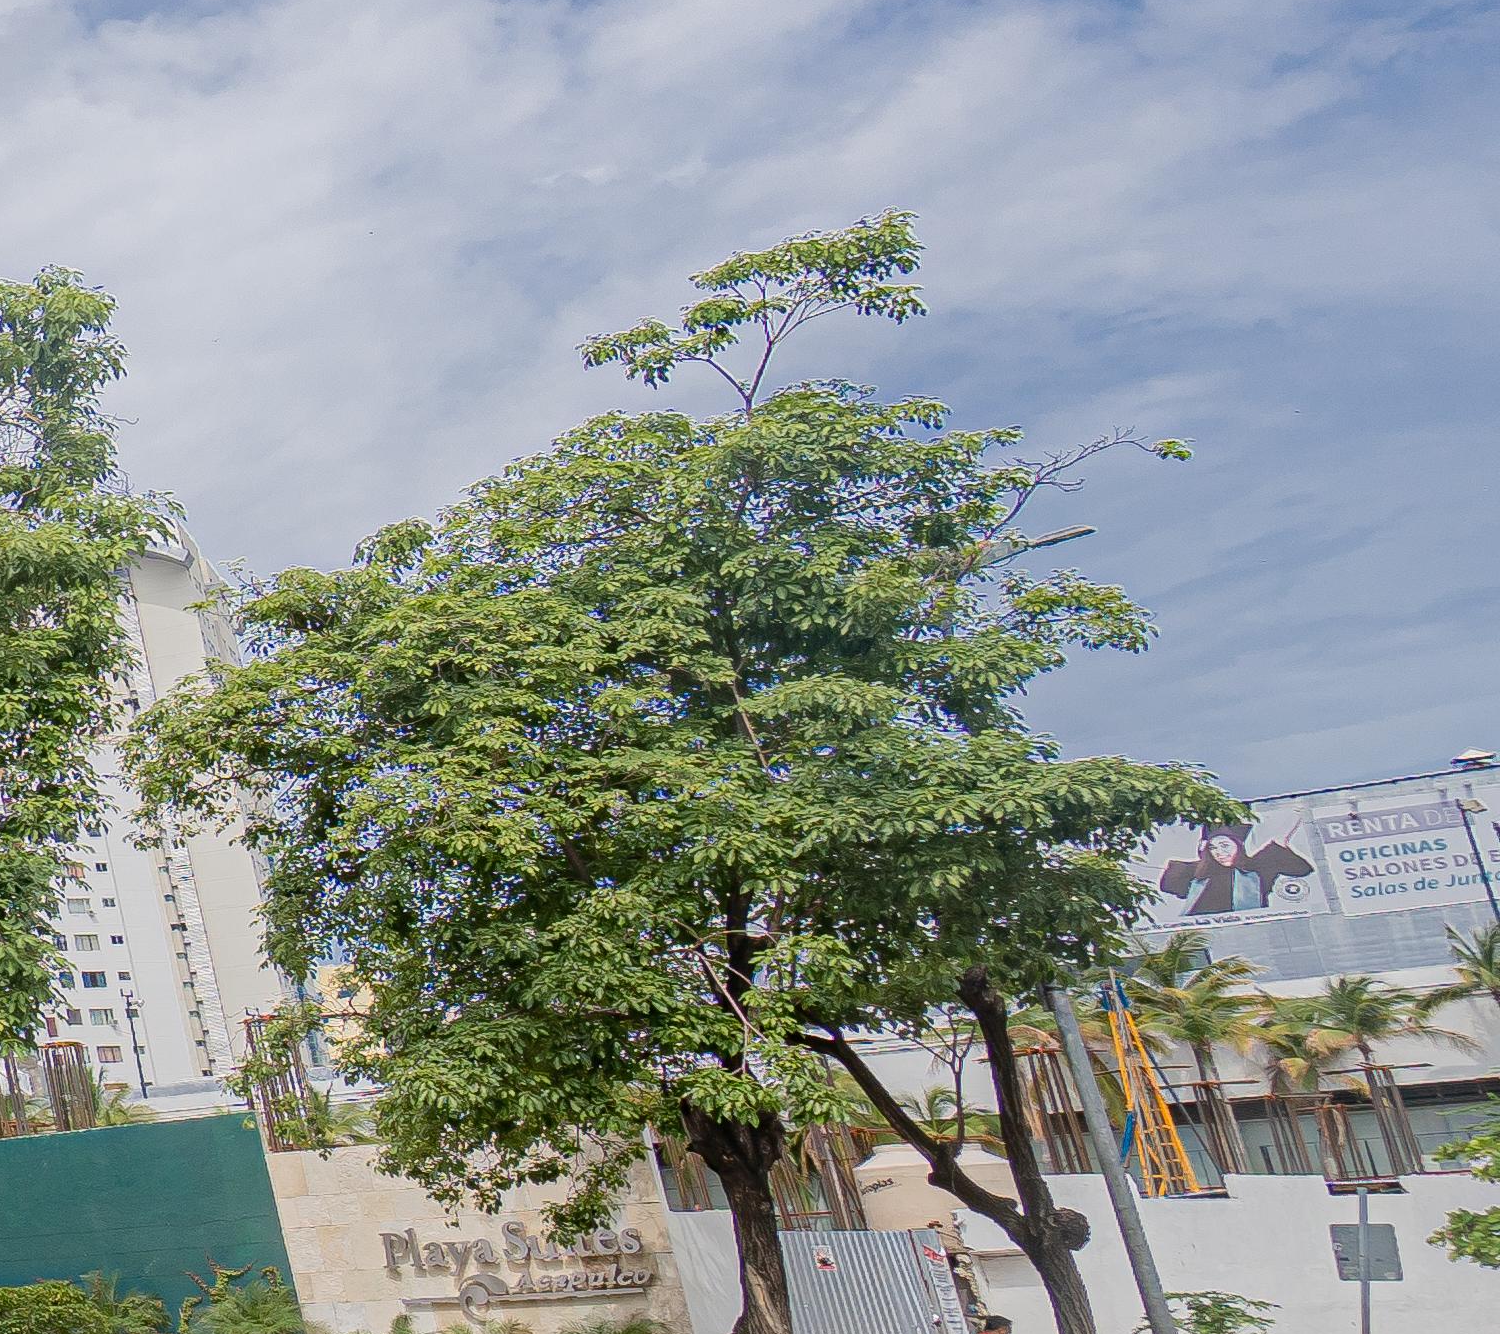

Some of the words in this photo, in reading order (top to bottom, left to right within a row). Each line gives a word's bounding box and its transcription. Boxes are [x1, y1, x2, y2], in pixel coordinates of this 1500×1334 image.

[1325, 812, 1420, 840] RENTA
[1421, 807, 1461, 827] DE
[1339, 838, 1448, 864] OFICINAS
[1344, 856, 1449, 881] SALONES
[1350, 880, 1409, 899] Salas
[1413, 876, 1440, 892] de
[378, 1226, 500, 1276] Playa
[515, 1262, 653, 1293] Acapulco
